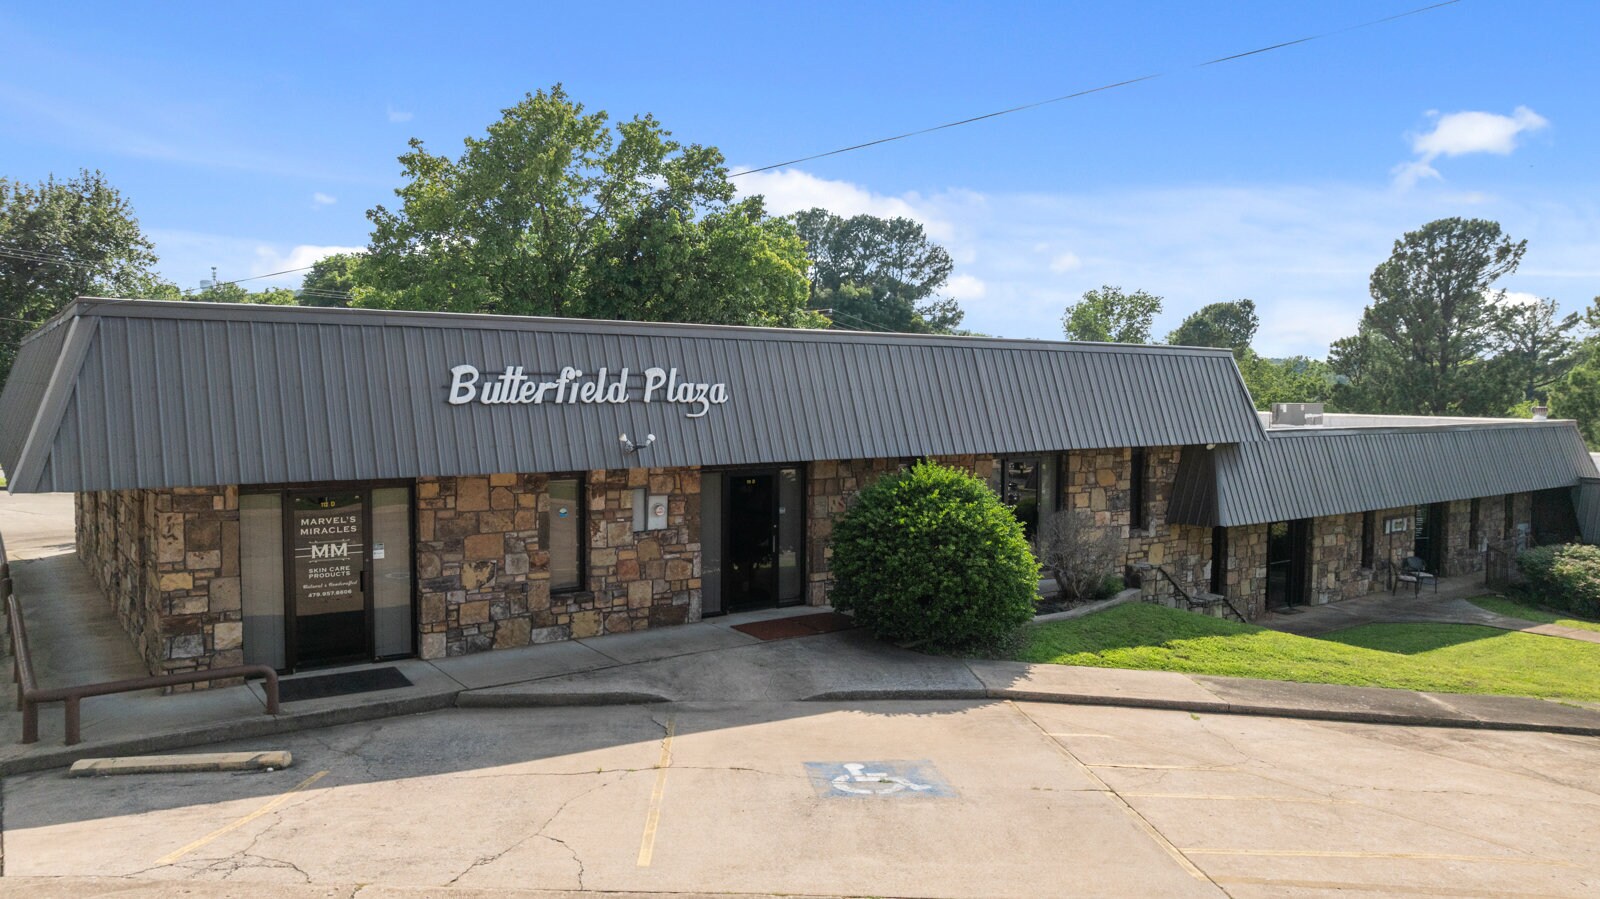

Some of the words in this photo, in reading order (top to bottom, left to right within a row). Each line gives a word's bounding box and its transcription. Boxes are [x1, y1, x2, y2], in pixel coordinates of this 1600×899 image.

[449, 364, 629, 404] Butterfield
[644, 367, 728, 418] Plaza
[300, 516, 356, 526] MARVEL'S
[300, 525, 357, 536] MIRACLES
[311, 542, 348, 559] MM
[308, 571, 351, 579] PRODUCTS
